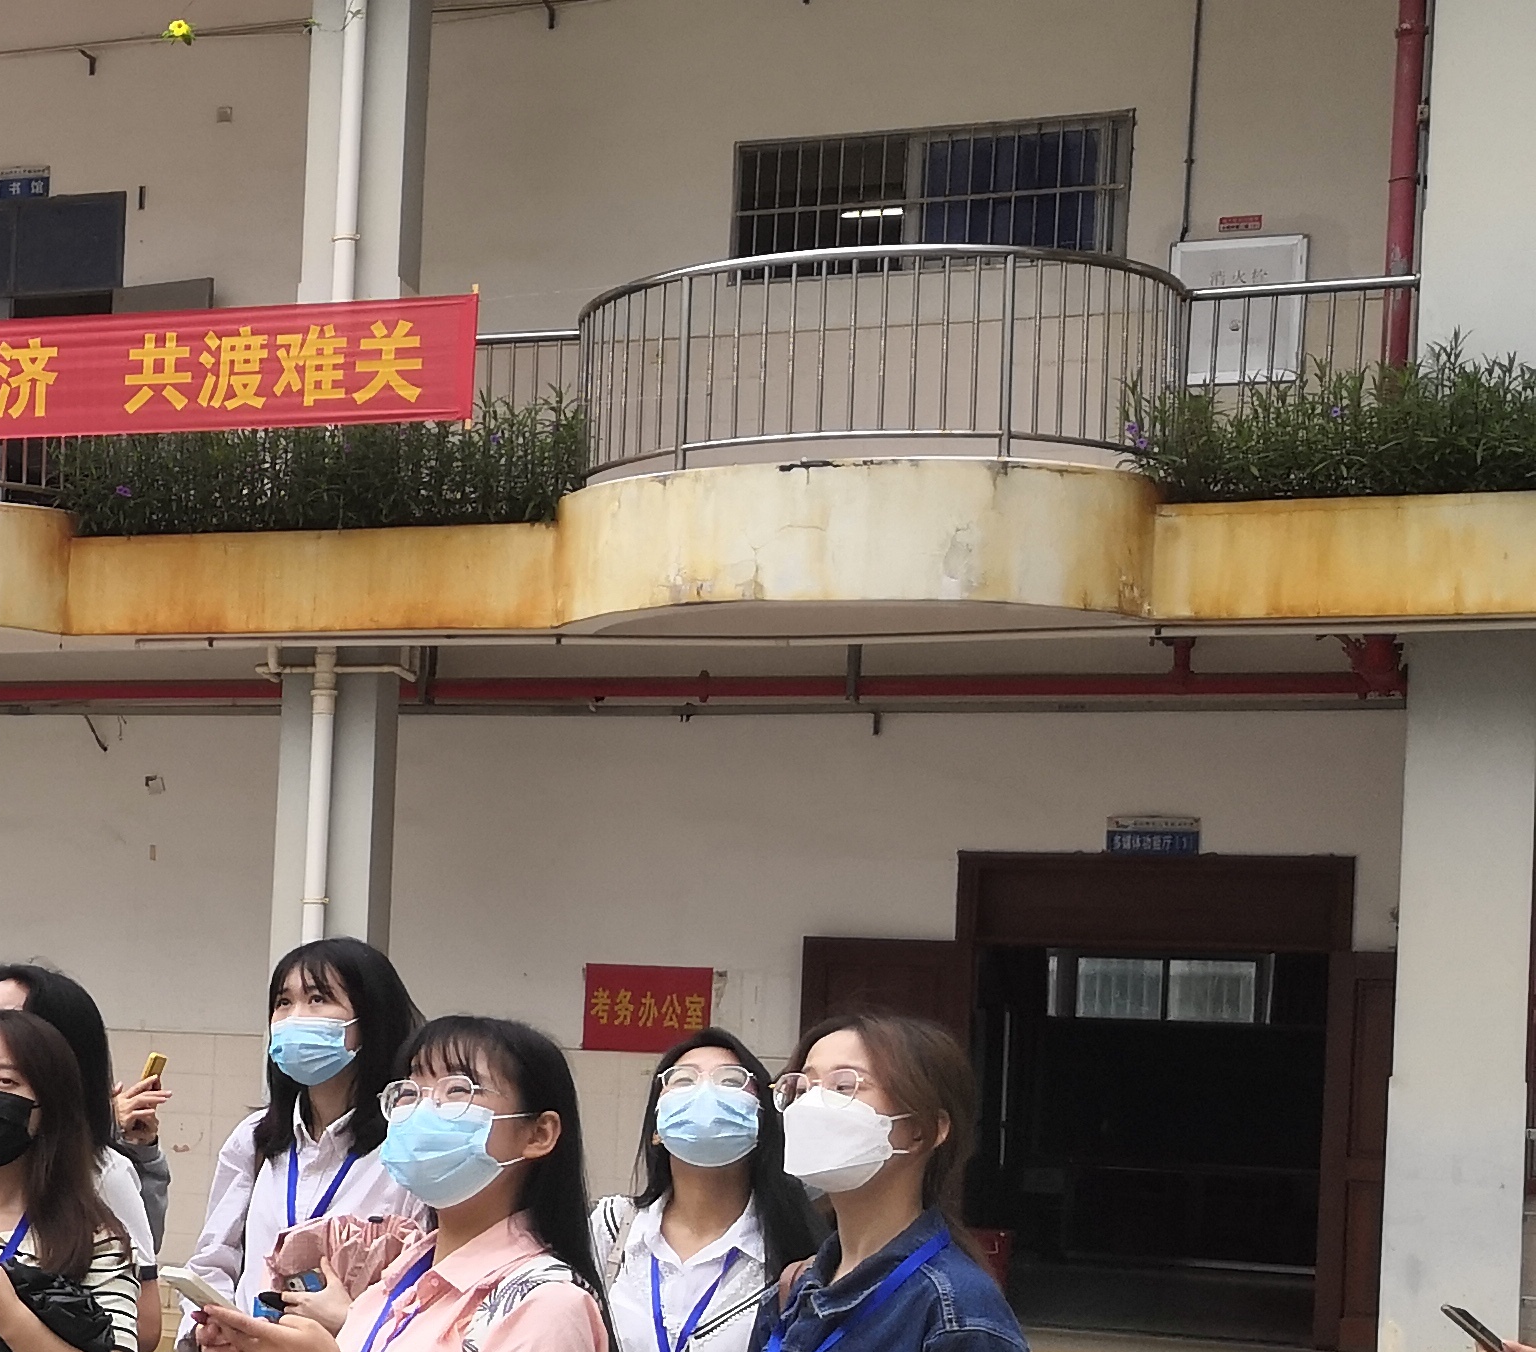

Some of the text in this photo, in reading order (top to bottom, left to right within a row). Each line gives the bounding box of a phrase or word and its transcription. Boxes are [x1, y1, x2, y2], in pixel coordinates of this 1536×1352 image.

[123, 318, 424, 414] 共渡难关
[590, 987, 706, 1031] 考务办公室
